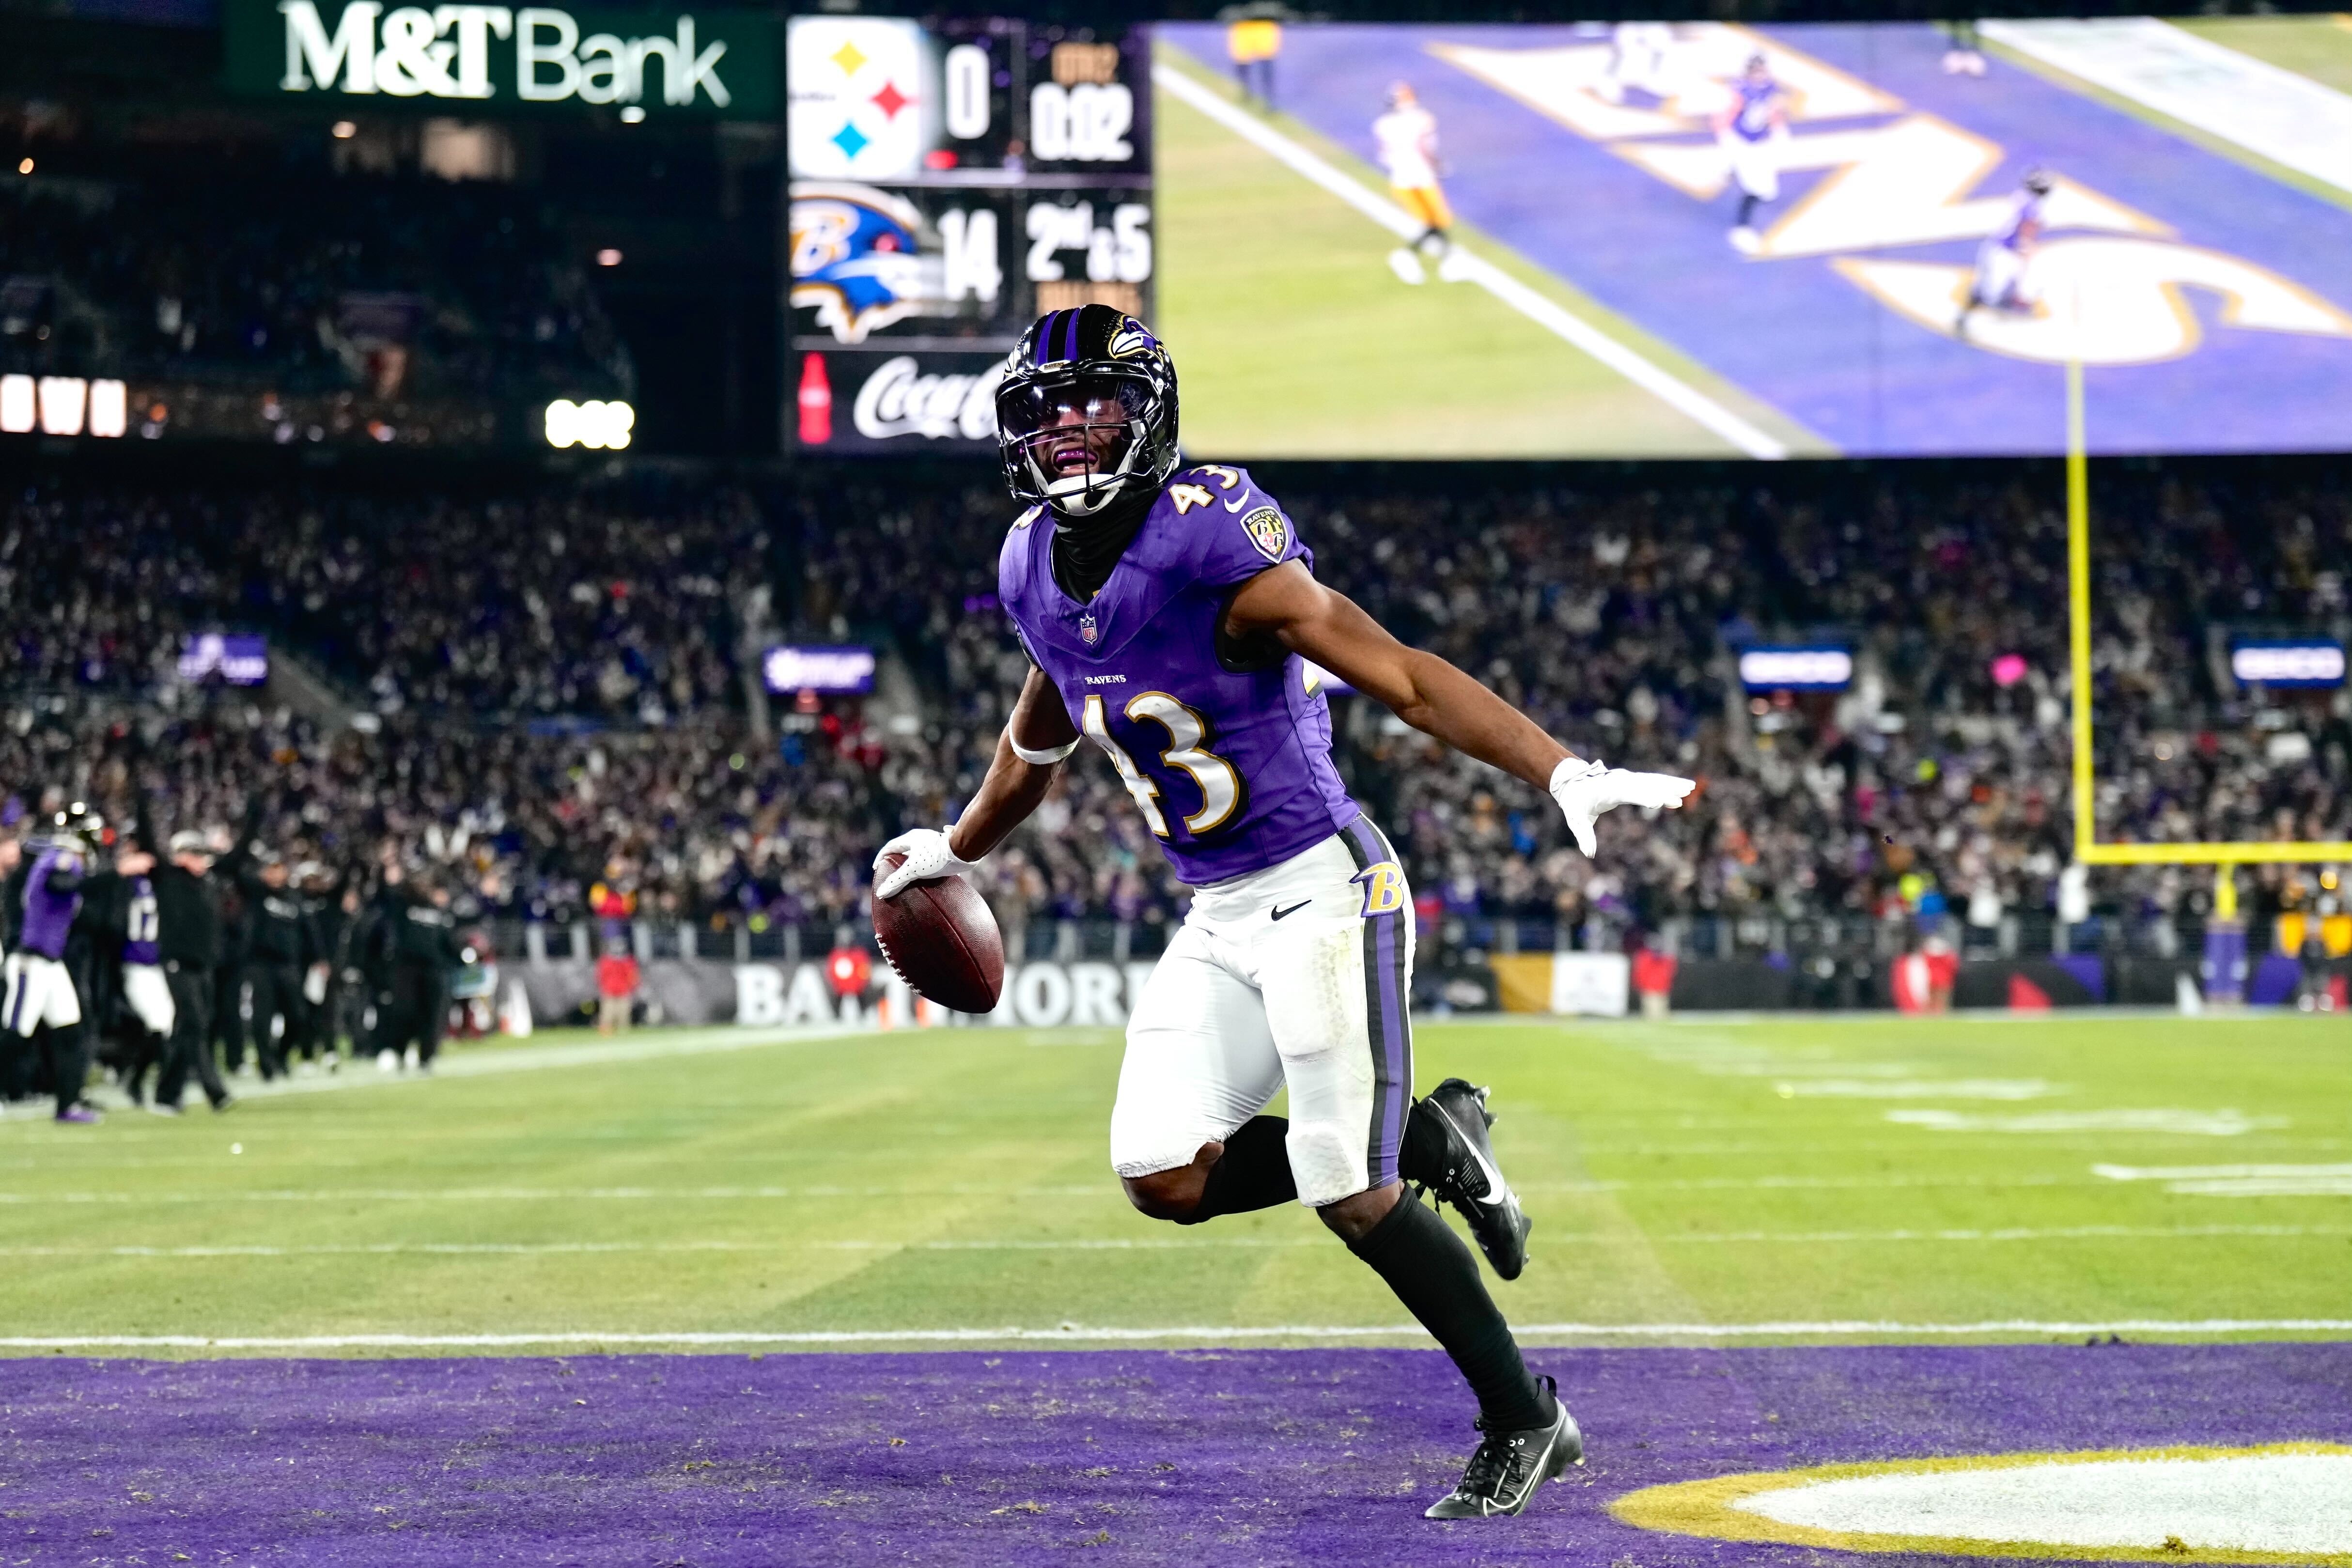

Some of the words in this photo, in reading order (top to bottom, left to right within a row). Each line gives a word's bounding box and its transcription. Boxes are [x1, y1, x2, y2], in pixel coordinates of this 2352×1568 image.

[278, 0, 512, 98] M&T
[515, 7, 732, 108] Bank
[945, 44, 990, 140] 0
[938, 206, 1002, 302] 14
[1168, 464, 1241, 515] 43
[1246, 510, 1275, 525] RAVENS
[1084, 628, 1095, 639] NFL
[1085, 674, 1126, 685] RAVENS
[1082, 691, 1240, 837] 43
[1350, 861, 1404, 917] B
